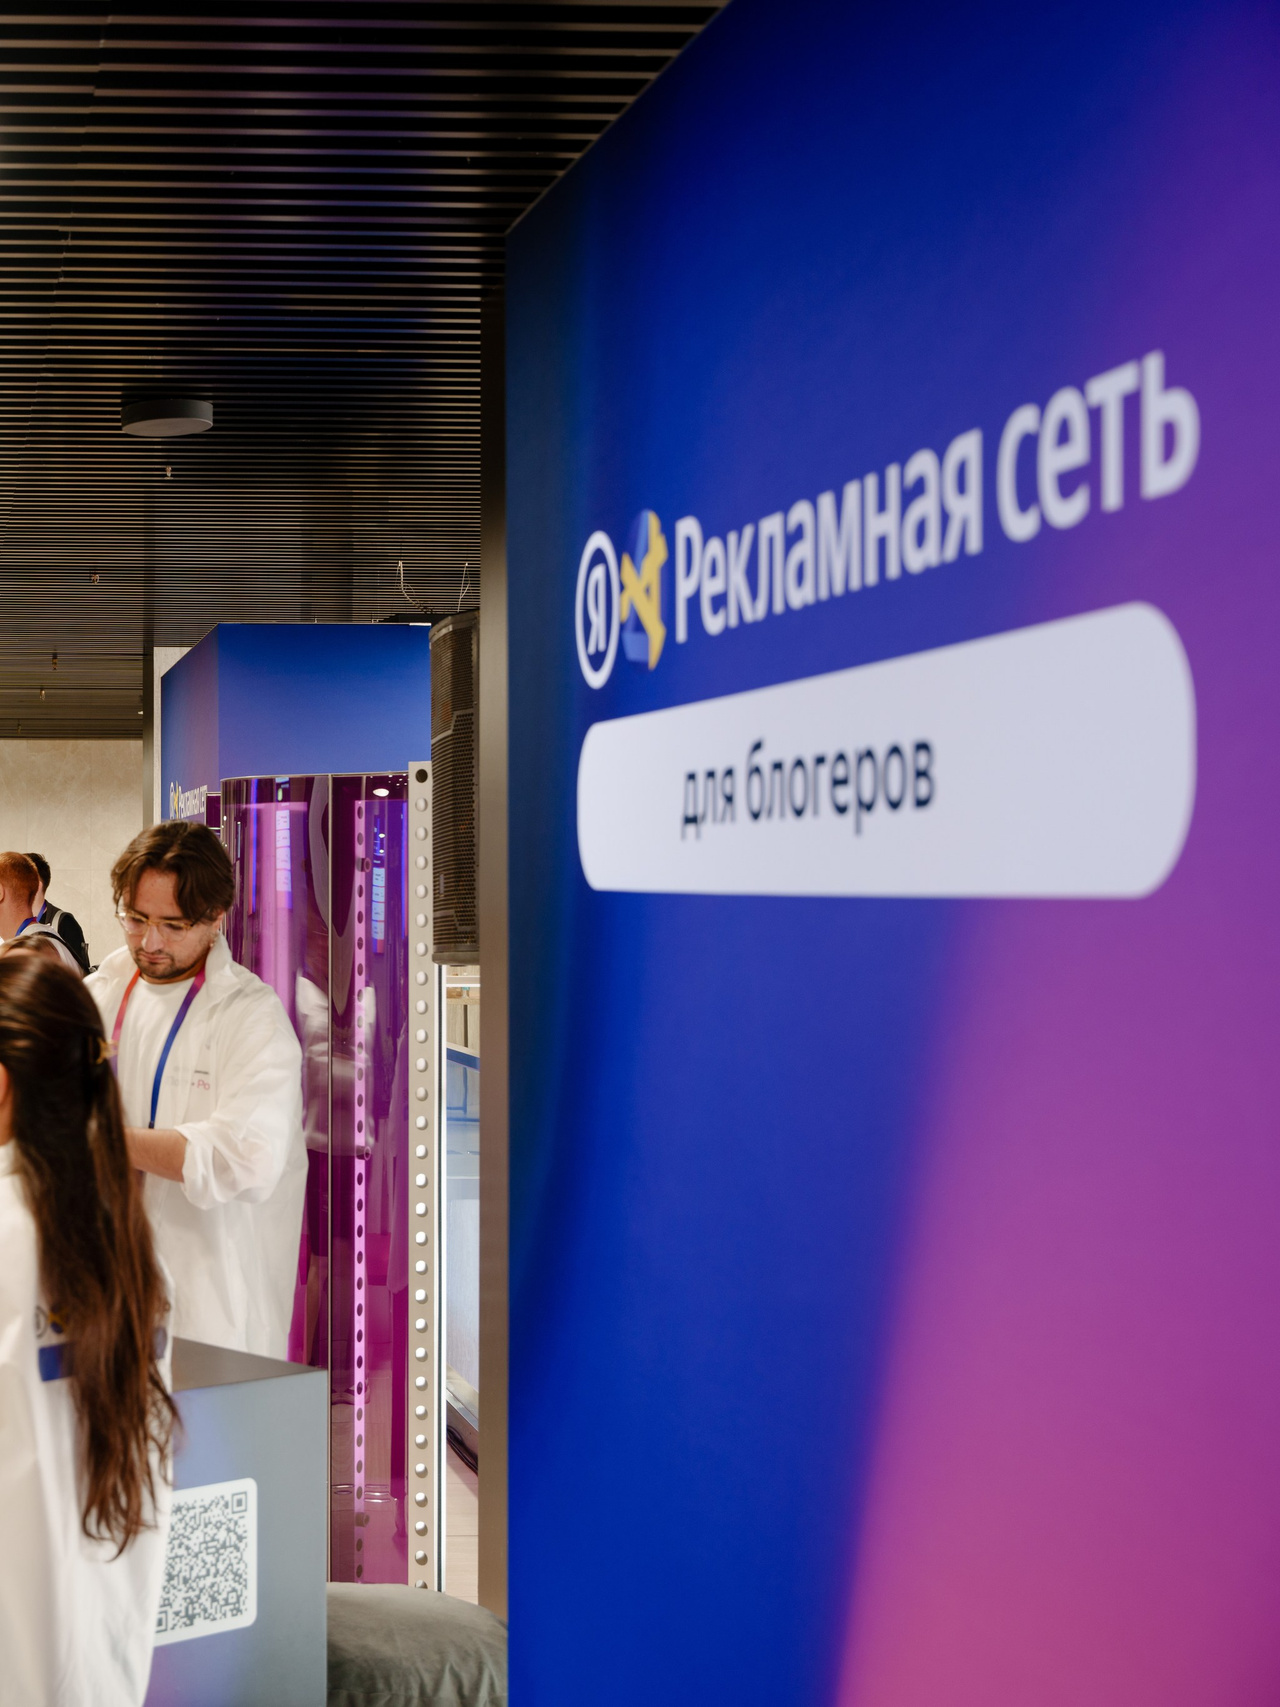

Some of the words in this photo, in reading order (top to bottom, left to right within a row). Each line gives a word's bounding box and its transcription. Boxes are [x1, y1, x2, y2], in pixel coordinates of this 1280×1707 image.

[675, 427, 983, 644] Рекламная
[996, 349, 1201, 544] сеть
[681, 767, 736, 841] для
[745, 738, 937, 837] блогеров
